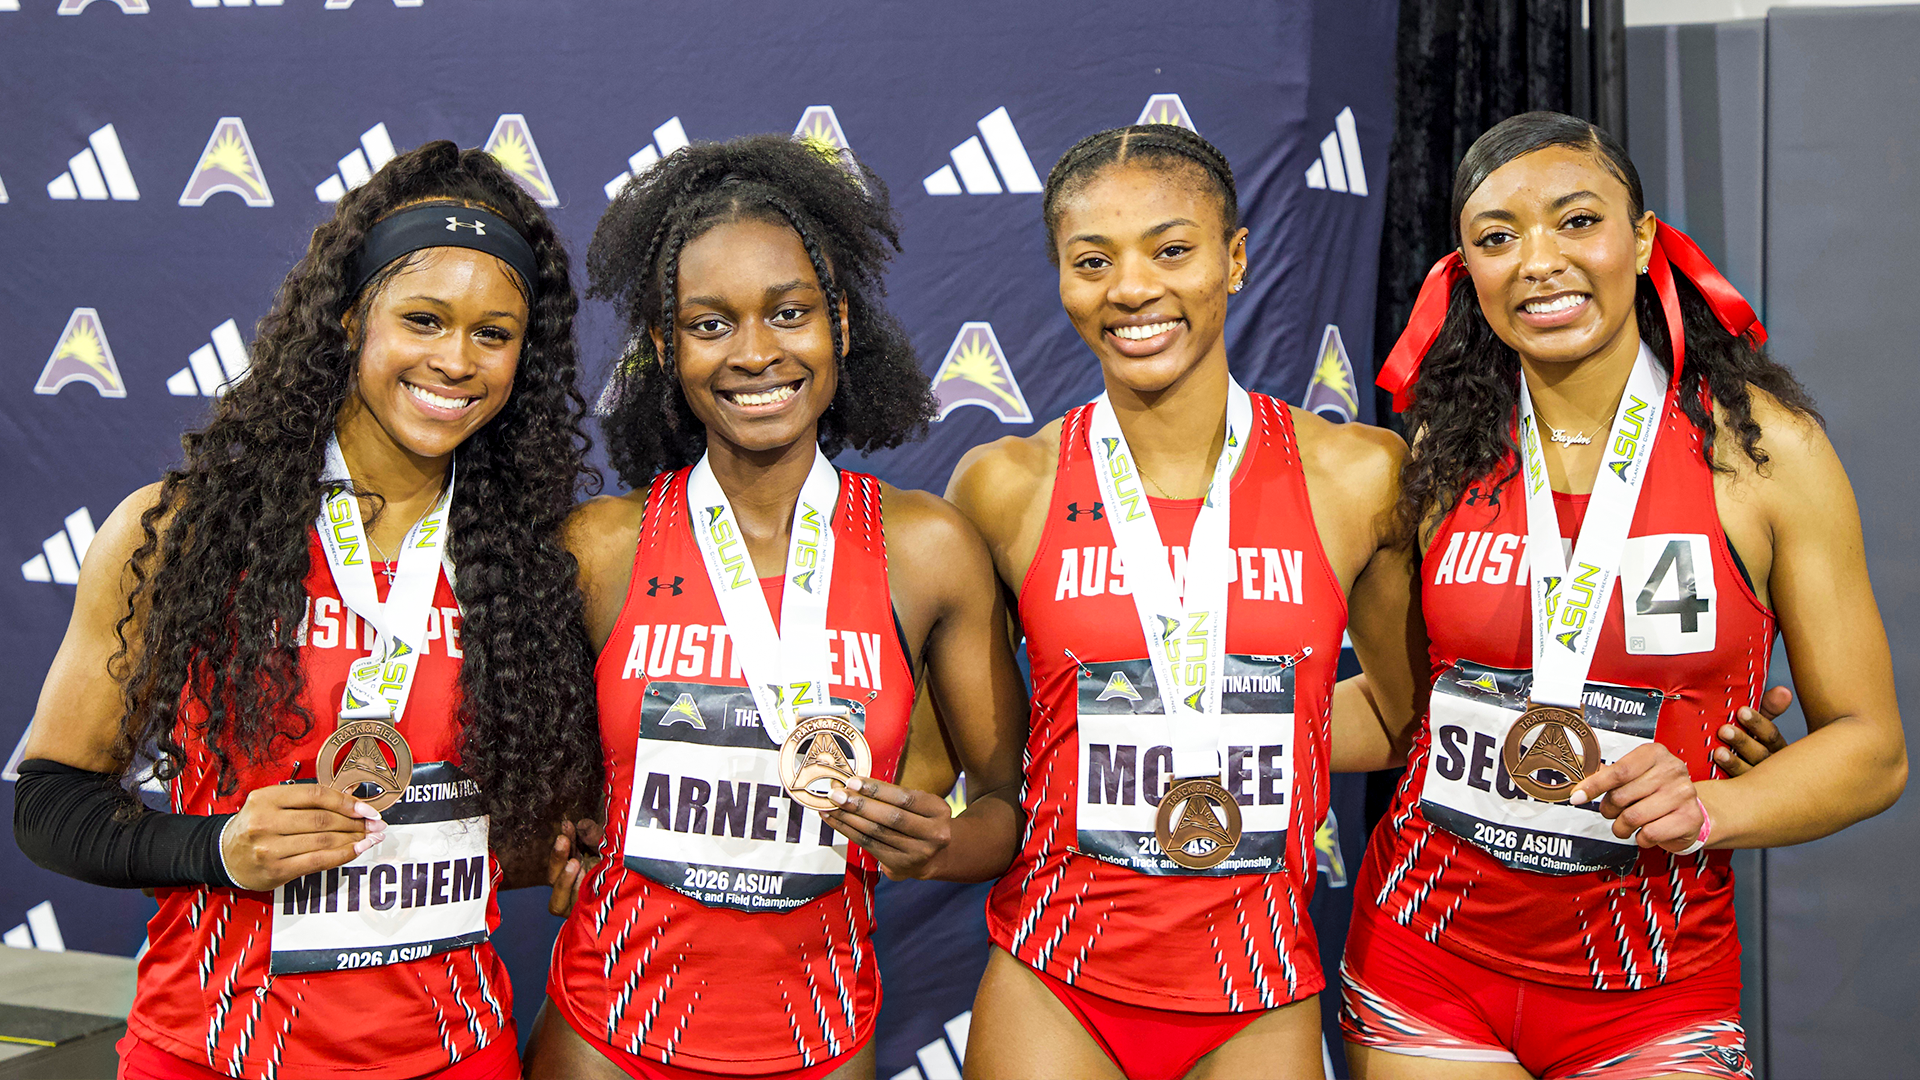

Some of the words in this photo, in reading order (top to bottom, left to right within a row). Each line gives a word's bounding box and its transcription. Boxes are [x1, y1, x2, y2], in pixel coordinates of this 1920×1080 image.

[1642, 405, 1656, 442] CONFERENCE
[1638, 442, 1647, 457] SUN
[1630, 456, 1642, 486] ATLANTIC
[1636, 540, 1709, 633] 4
[1580, 626, 1593, 655] ATLANTIC
[1589, 611, 1598, 624] SUN
[1594, 570, 1610, 609] CONFERENCE
[824, 629, 883, 691] EAY
[1222, 675, 1285, 694] TINATION.
[1583, 691, 1646, 717] TINATION.
[332, 726, 363, 746] TRACK
[365, 724, 373, 733] &
[375, 725, 400, 746] FIELD
[791, 721, 821, 743] TRACK
[820, 719, 830, 729] &
[831, 721, 857, 741] FIELD
[1519, 711, 1551, 730] TRACK
[1553, 711, 1561, 721] &
[1563, 714, 1589, 738] FIELD
[1087, 743, 1285, 807] MCEE
[1167, 785, 1194, 806] TRACK
[1196, 784, 1203, 792] &
[1205, 784, 1228, 802] FIELD
[1474, 822, 1518, 849] 2026
[1521, 833, 1573, 858] ASUN
[1131, 856, 1158, 868] Track
[1493, 849, 1512, 861] and
[1514, 852, 1539, 866] Field
[283, 855, 485, 916] MITCHEM
[684, 868, 730, 891] 2026
[733, 872, 784, 895] ASUN
[704, 892, 724, 904] and
[726, 893, 750, 906] Field
[337, 951, 383, 970] 2026
[387, 944, 433, 965] ASUN
